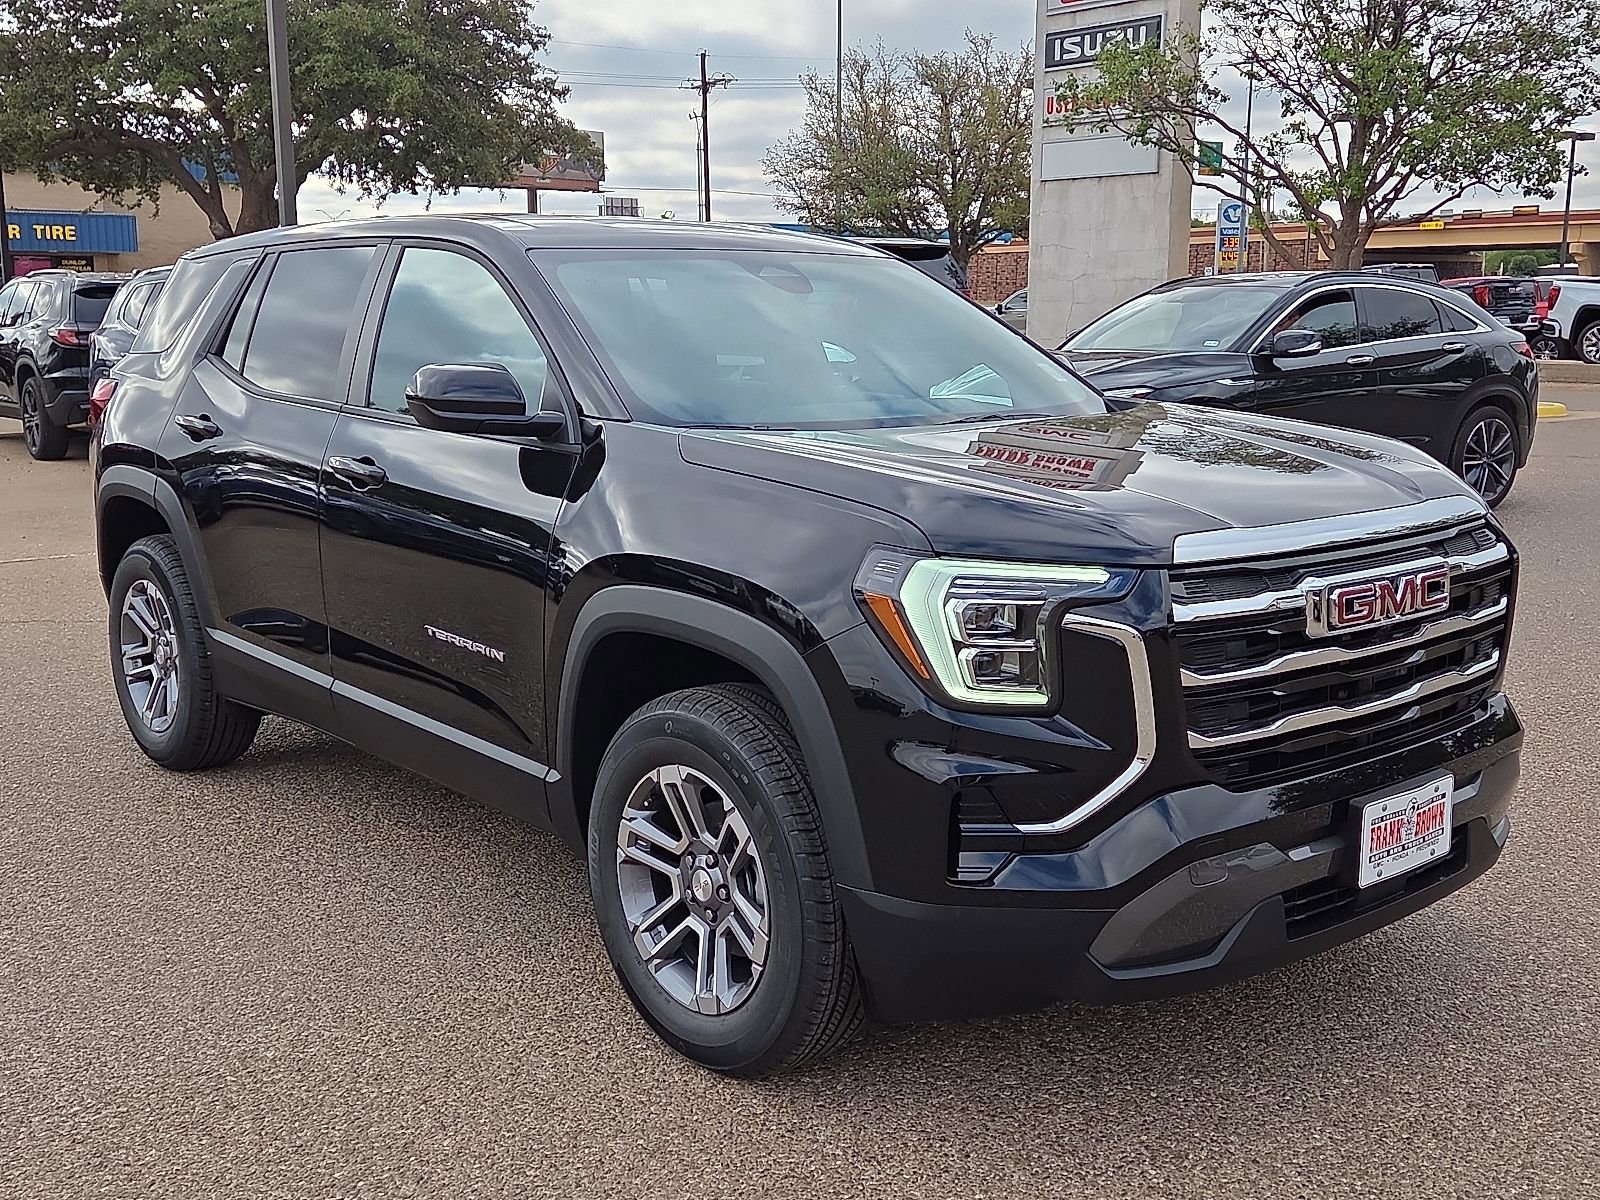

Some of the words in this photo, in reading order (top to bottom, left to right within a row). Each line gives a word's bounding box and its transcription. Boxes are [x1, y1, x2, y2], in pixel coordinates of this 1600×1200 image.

[1054, 25, 1147, 61] ISUZU
[32, 224, 77, 240] TIRE
[1333, 568, 1450, 627] GMC
[423, 624, 506, 662] TERRAIN
[1369, 817, 1406, 854] FRANK
[1414, 801, 1446, 838] BROWN
